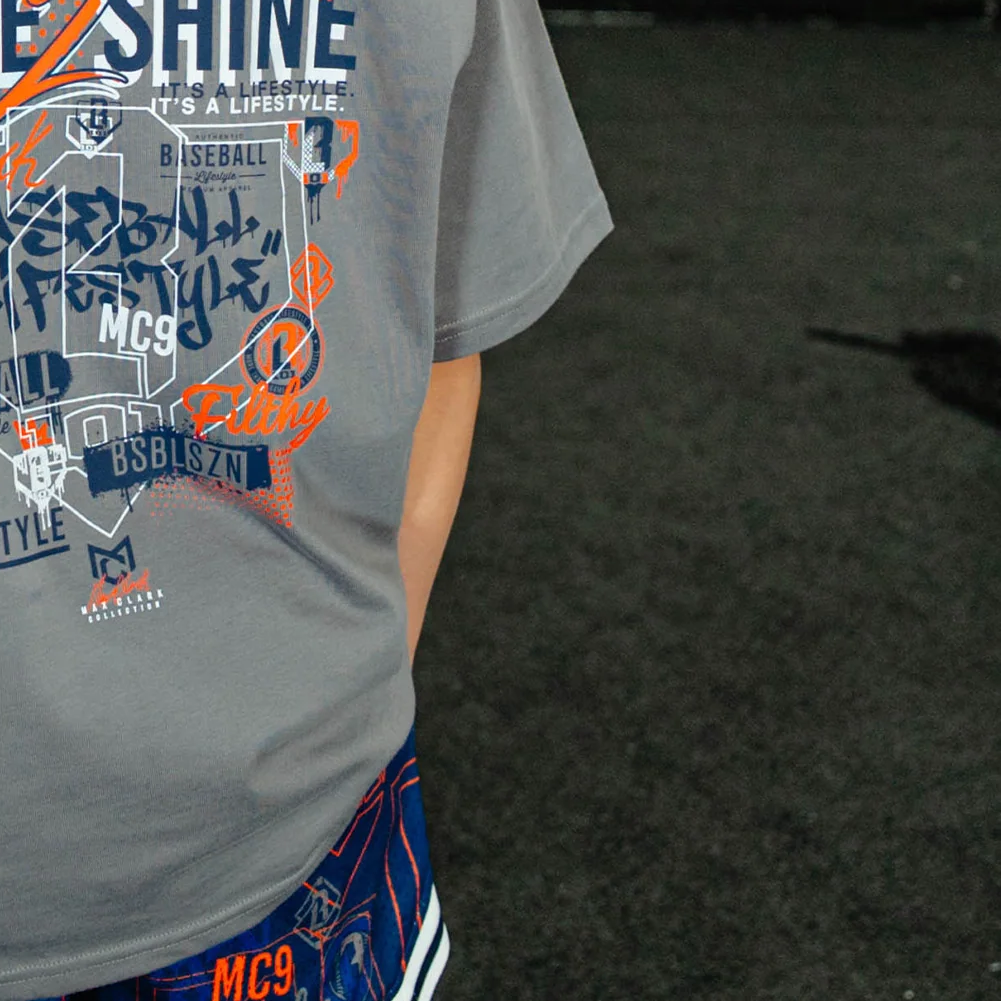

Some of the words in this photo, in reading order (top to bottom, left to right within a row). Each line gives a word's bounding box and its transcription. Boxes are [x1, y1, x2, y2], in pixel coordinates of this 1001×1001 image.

[215, 82, 229, 98] A
[150, 97, 196, 115] IT'S
[205, 96, 220, 115] A
[229, 94, 345, 115] LIFESTYLE.
[160, 142, 267, 167] BASEBALL
[99, 303, 176, 357] MC9
[182, 375, 331, 450] Filthy
[80, 601, 108, 616] MAX
[116, 588, 164, 607] CLARK
[211, 944, 294, 1001] MC9
